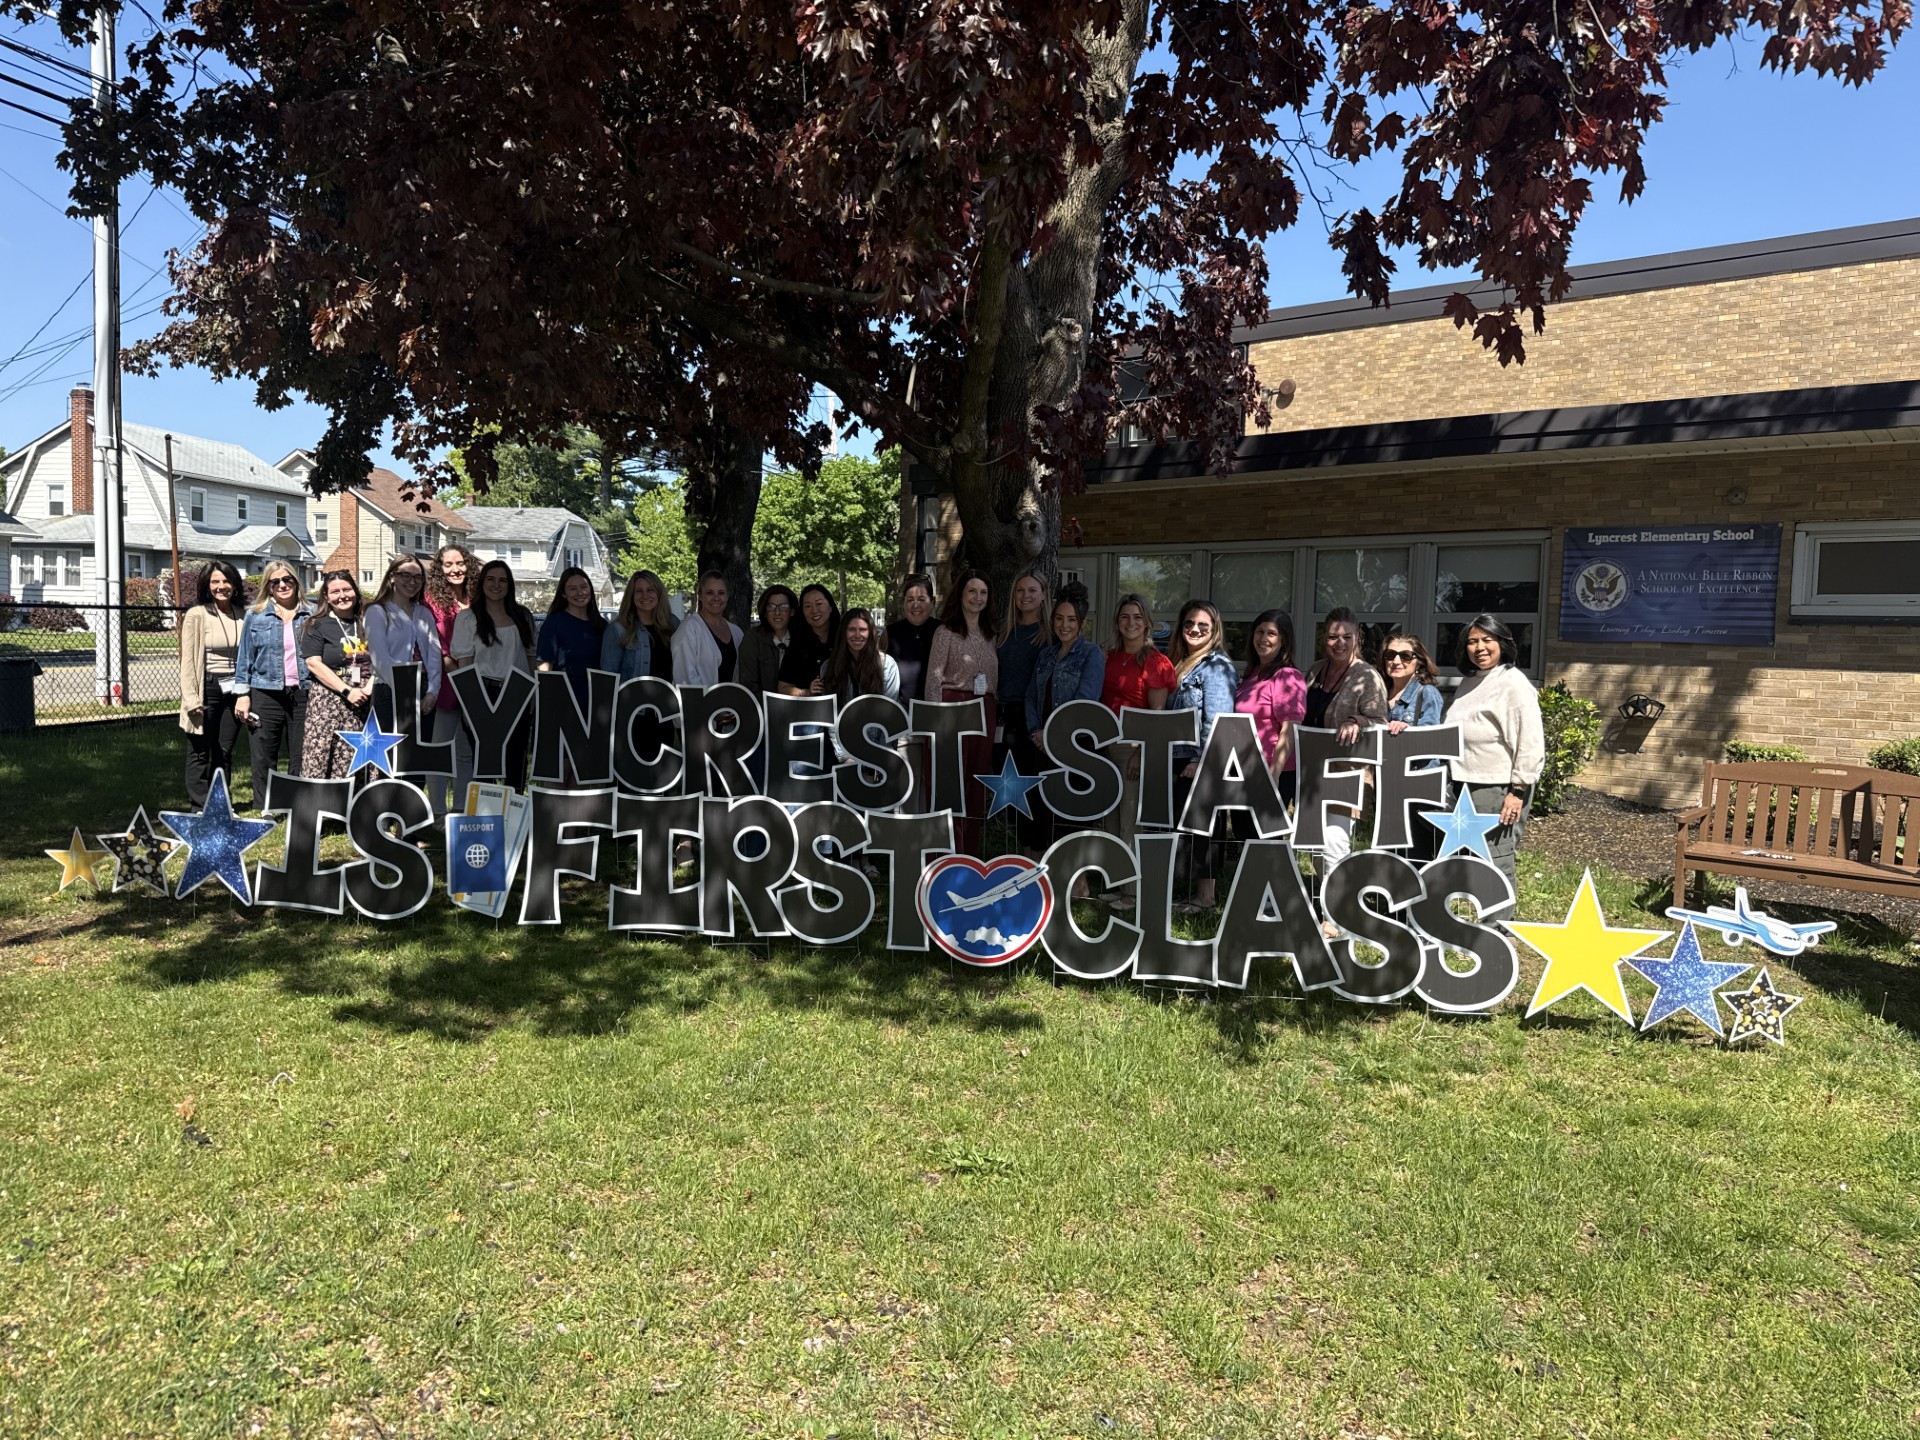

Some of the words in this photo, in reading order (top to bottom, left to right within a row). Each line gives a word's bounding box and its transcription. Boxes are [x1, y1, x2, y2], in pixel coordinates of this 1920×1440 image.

[1587, 532, 1637, 545] Lyncrest
[1640, 531, 1710, 543] Elementary
[1712, 529, 1754, 541] School
[1637, 570, 1647, 581] A
[1649, 569, 1698, 581] NATIONAL
[1702, 569, 1729, 581] BLUE
[1733, 569, 1773, 580] RIBBON
[1640, 582, 1679, 594] SCHOOL
[391, 662, 986, 815] LYNCREST
[1039, 700, 1463, 849] STAFF
[459, 823, 495, 832] PASSPORT
[254, 769, 434, 920] IS
[517, 786, 956, 951] FIRST
[1039, 830, 1519, 1012] CLASS
